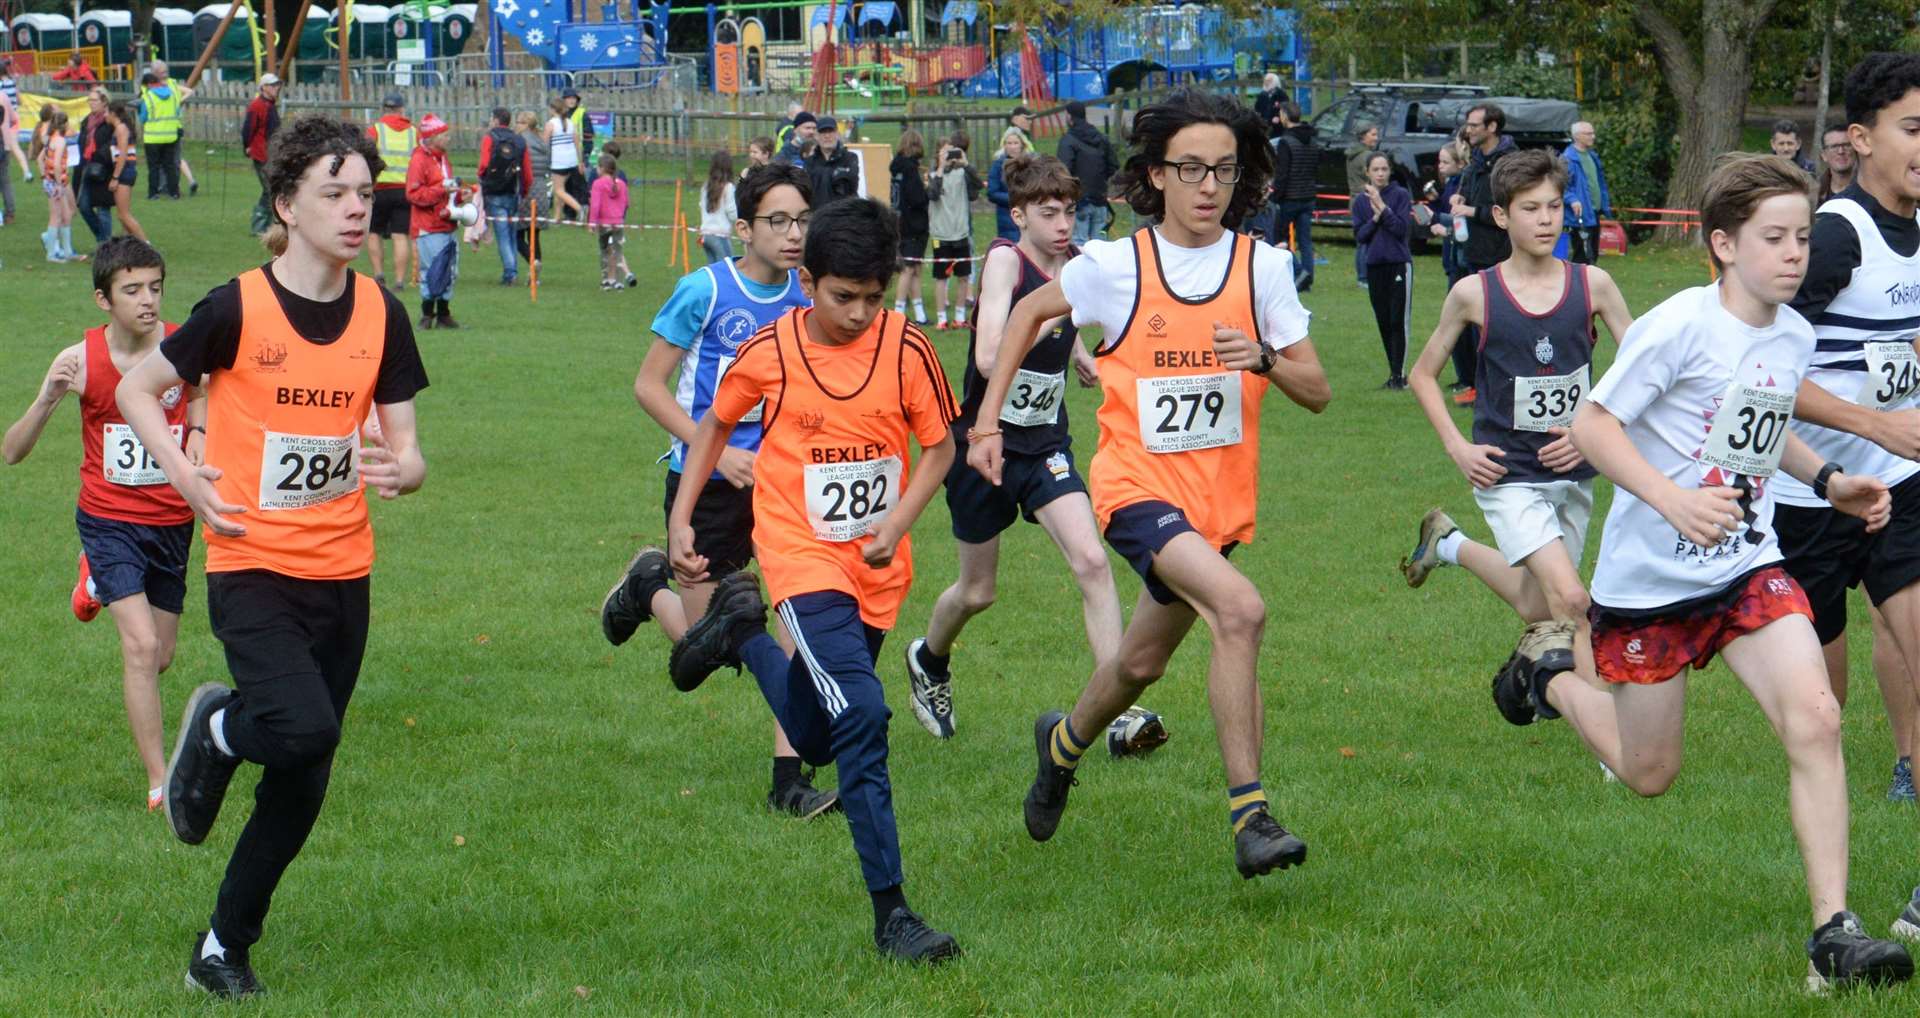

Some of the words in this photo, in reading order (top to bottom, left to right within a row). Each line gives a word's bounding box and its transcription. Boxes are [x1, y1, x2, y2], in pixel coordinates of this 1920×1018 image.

[1170, 378, 1193, 386] CROSS
[1195, 376, 1226, 385] COUNTRY
[276, 386, 355, 408] BEXLEY
[1011, 384, 1058, 411] 346
[1528, 384, 1581, 418] 339
[1156, 391, 1224, 433] 279
[1180, 434, 1208, 442] COUNTY
[1728, 406, 1789, 455] 307
[287, 445, 317, 453] LEAGUE
[301, 438, 326, 446] CROSS
[1181, 438, 1226, 449] ASSOCIATION
[811, 443, 887, 463] BEXLEY
[276, 446, 353, 491] 284
[822, 474, 887, 521] 282
[1675, 542, 1740, 556] PALAE
